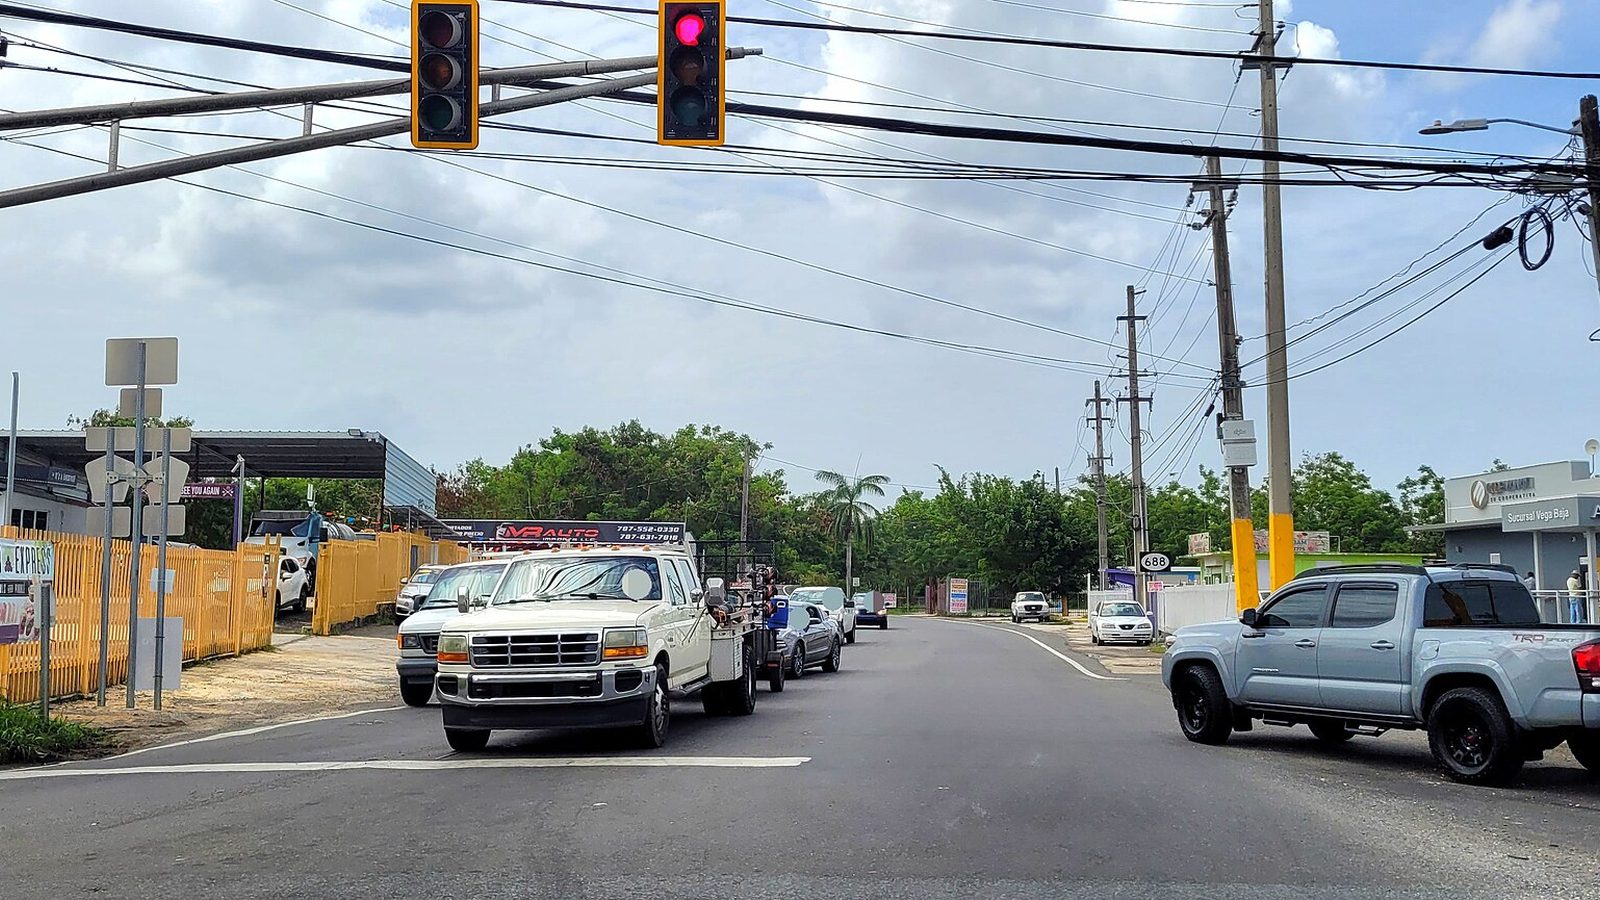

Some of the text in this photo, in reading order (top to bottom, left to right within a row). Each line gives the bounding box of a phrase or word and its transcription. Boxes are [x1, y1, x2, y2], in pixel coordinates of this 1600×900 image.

[191, 486, 203, 495] YOU
[203, 486, 220, 495] AGAIN
[1498, 492, 1536, 502] COOPERATIVA
[1507, 508, 1570, 523] Sucursal Vega Baja
[543, 528, 599, 537] AUTO
[15, 545, 52, 575] EXPRESS
[1145, 556, 1166, 567] 688
[1512, 633, 1545, 643] TRD
